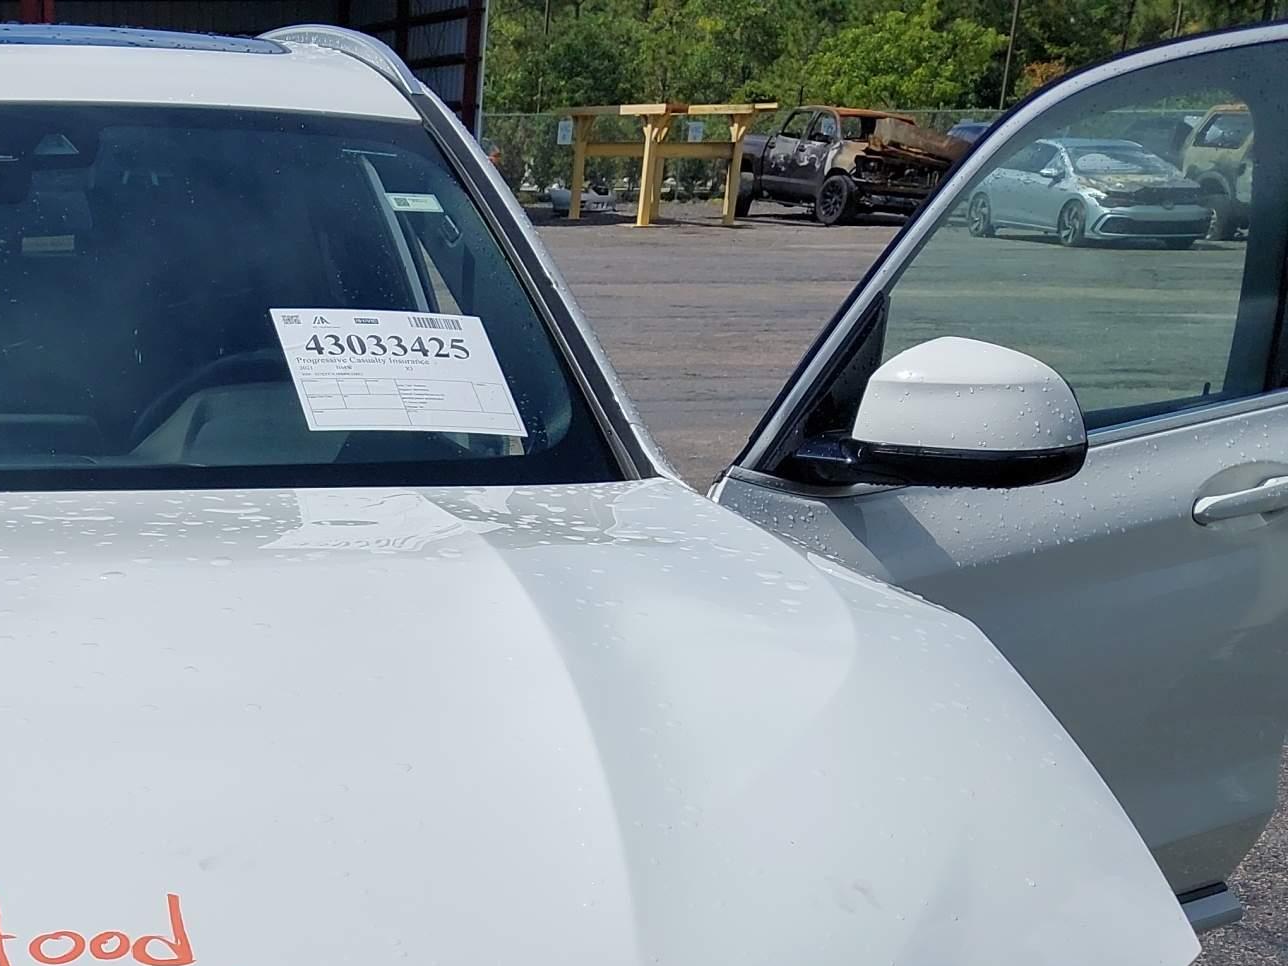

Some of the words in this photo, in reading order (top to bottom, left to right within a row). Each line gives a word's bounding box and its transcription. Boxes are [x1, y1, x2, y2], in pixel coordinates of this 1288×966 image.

[304, 334, 470, 360] 43033425
[296, 356, 347, 365] Progressive
[349, 356, 386, 365] Casualty
[388, 357, 430, 366] Insurance
